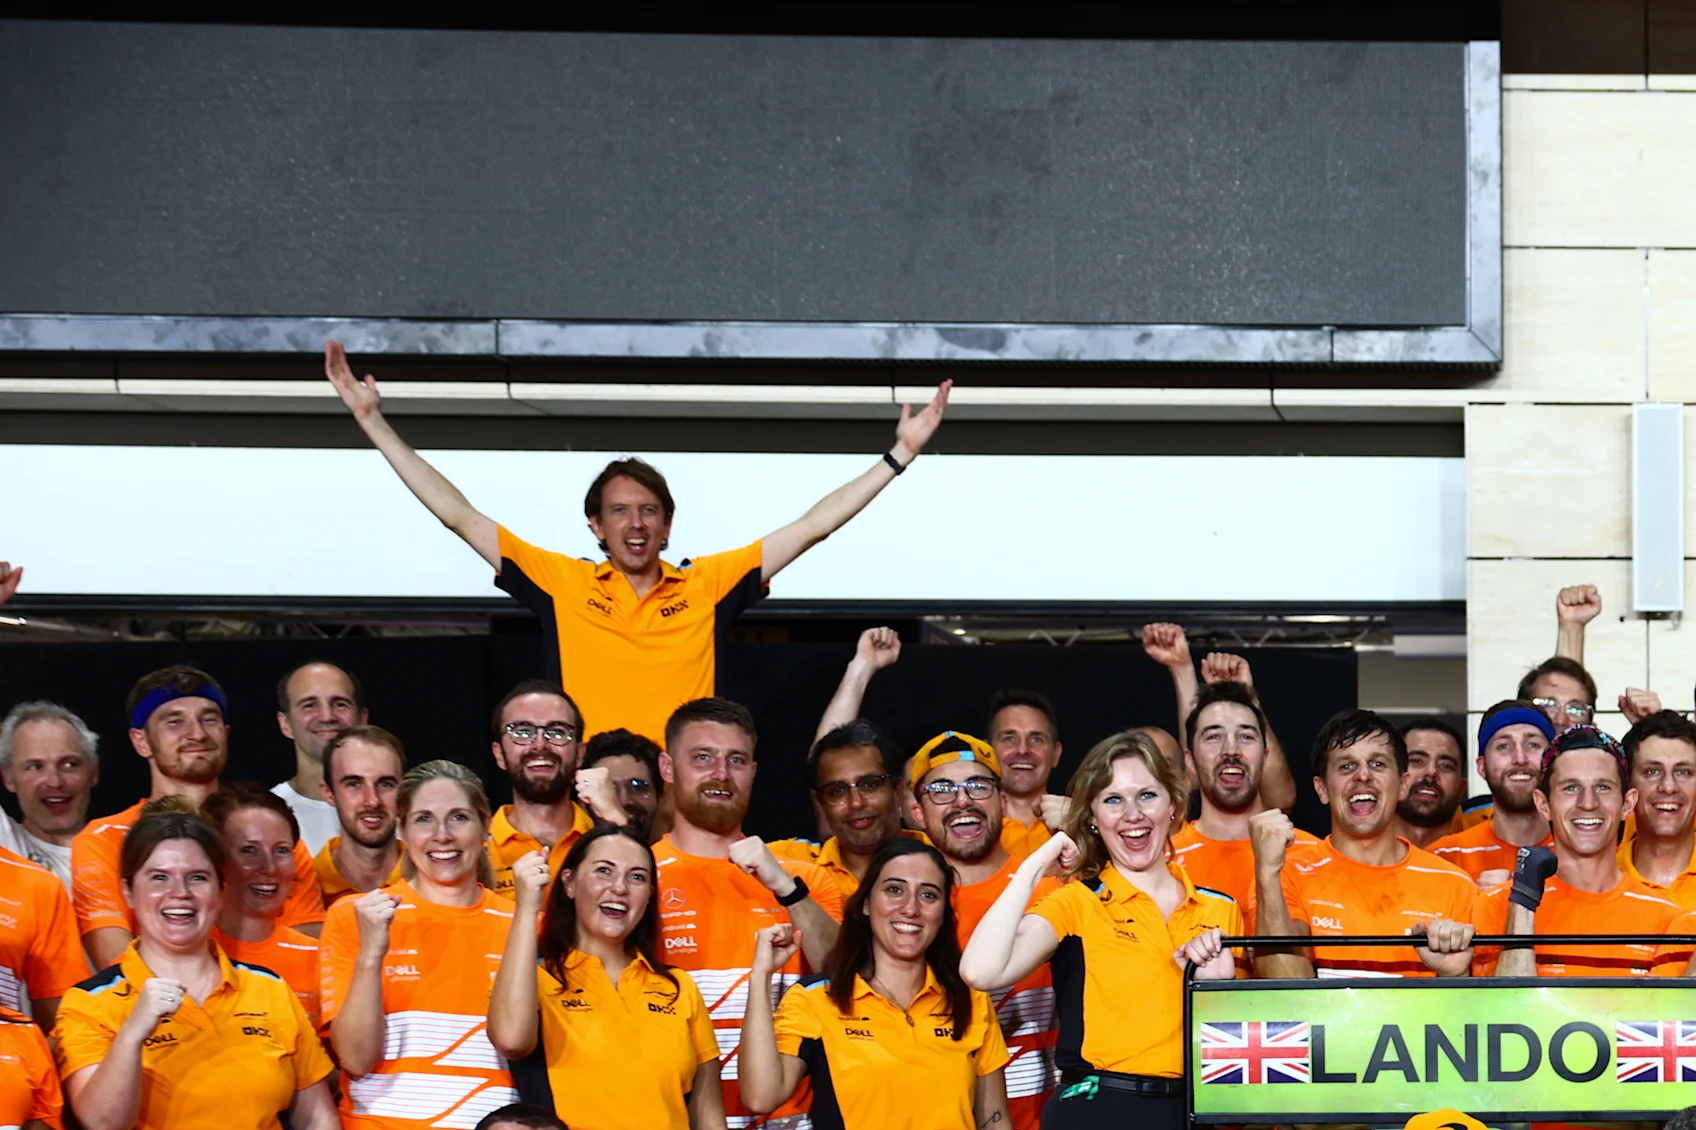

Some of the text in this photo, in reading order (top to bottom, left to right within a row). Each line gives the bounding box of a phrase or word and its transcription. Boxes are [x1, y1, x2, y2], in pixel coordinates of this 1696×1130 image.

[1312, 916, 1343, 929] DELL
[664, 936, 697, 948] DELL
[846, 1028, 873, 1037] DELL
[1311, 1021, 1611, 1083] LANDO
